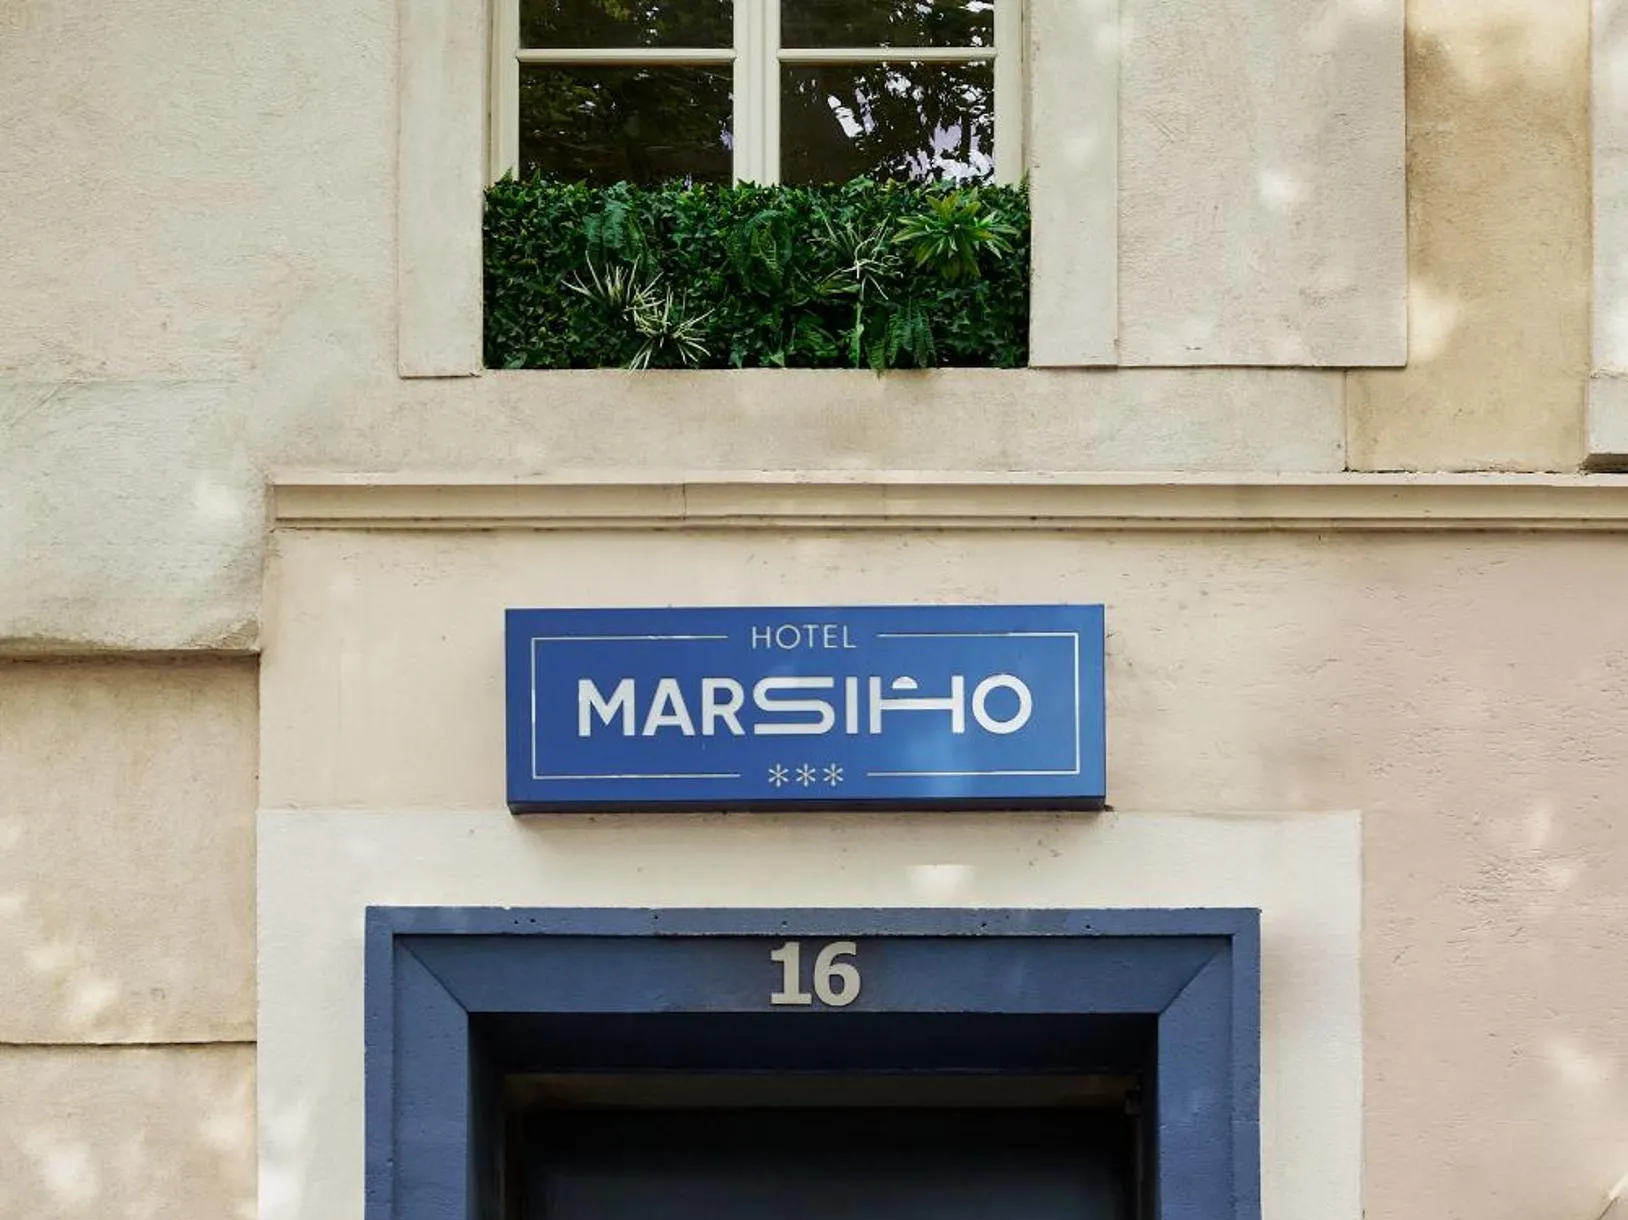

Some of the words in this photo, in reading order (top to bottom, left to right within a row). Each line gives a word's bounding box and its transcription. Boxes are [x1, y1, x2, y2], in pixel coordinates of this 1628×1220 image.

[751, 624, 857, 650] HOTEL
[578, 674, 1033, 736] MARSIHO
[770, 941, 860, 1007] 16
